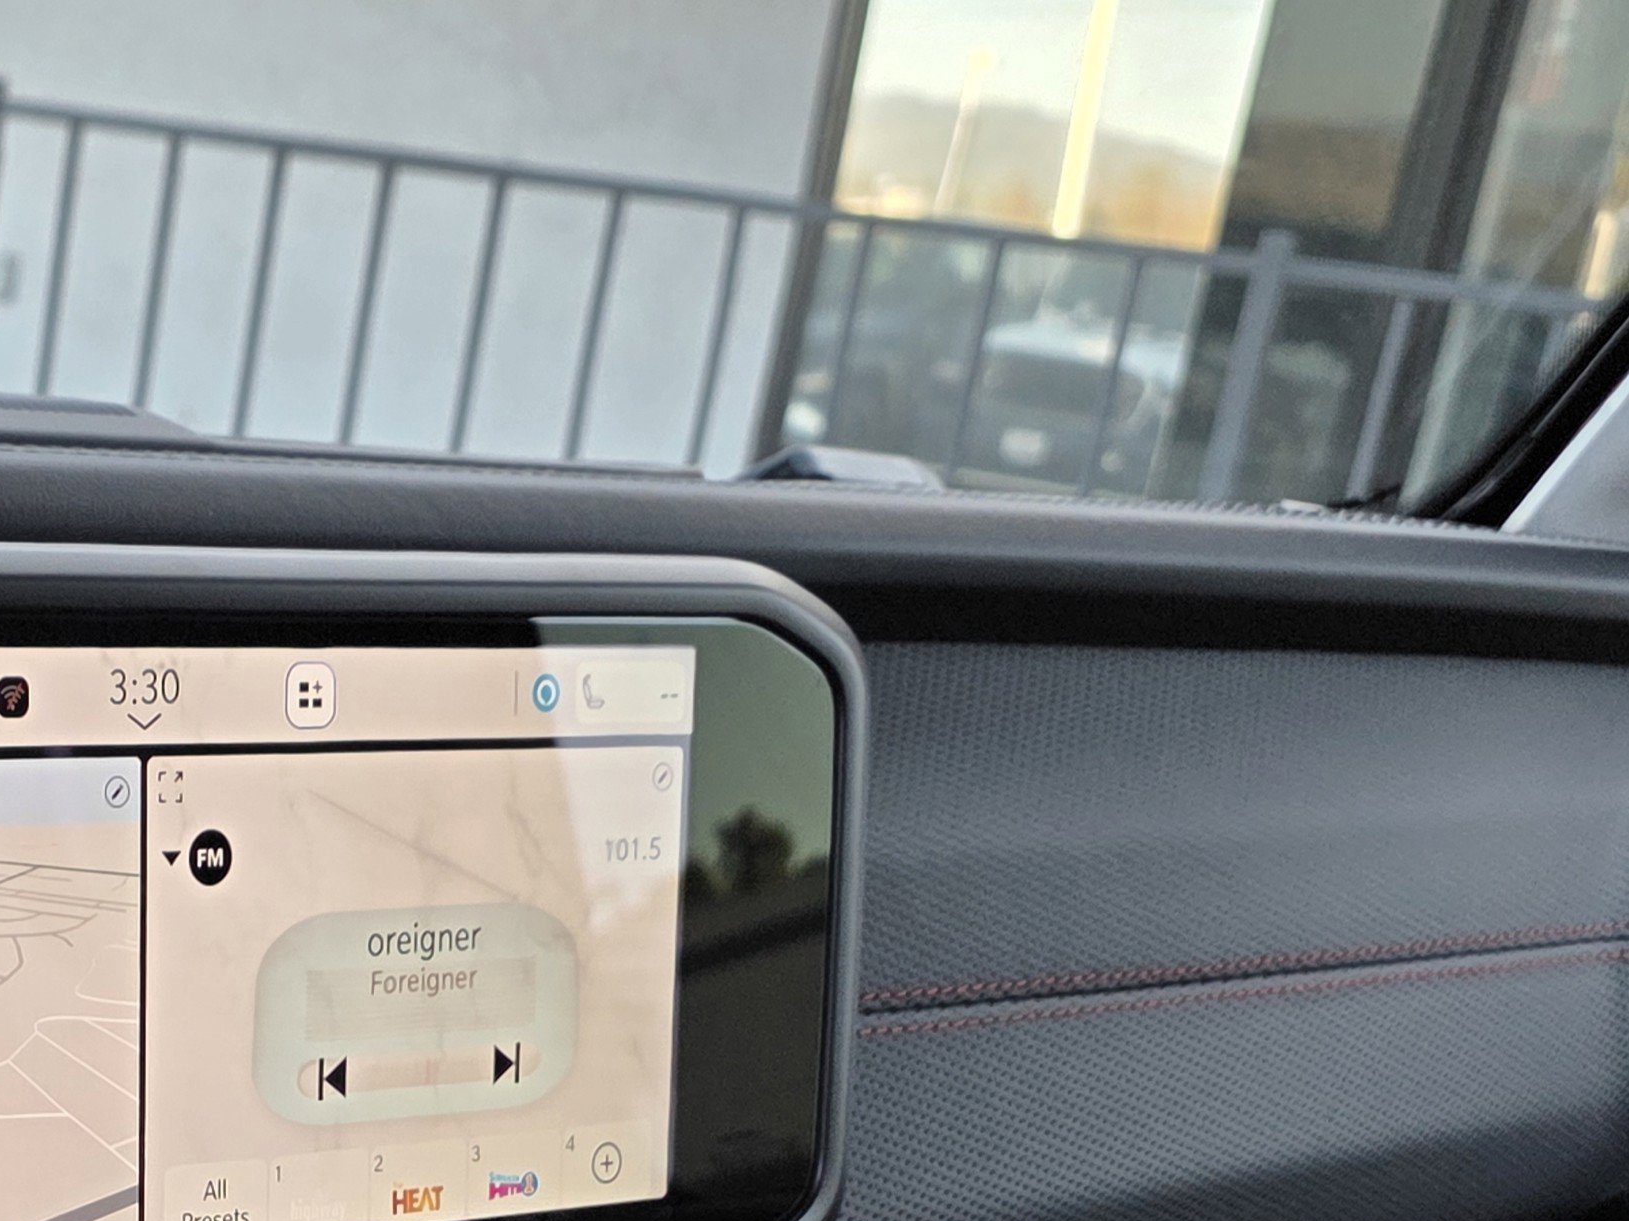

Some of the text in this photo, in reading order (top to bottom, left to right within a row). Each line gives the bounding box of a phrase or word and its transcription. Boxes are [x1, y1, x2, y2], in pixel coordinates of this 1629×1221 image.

[109, 668, 180, 705] 3:30
[196, 848, 224, 869] FM
[605, 836, 662, 862] 101.5
[367, 921, 482, 961] oreigner
[370, 966, 478, 997] Foreigner
[472, 1145, 481, 1162] 3
[565, 1134, 575, 1152] 4
[374, 1155, 384, 1172] 2
[203, 1178, 227, 1201] All
[392, 1185, 444, 1215] HEAT
